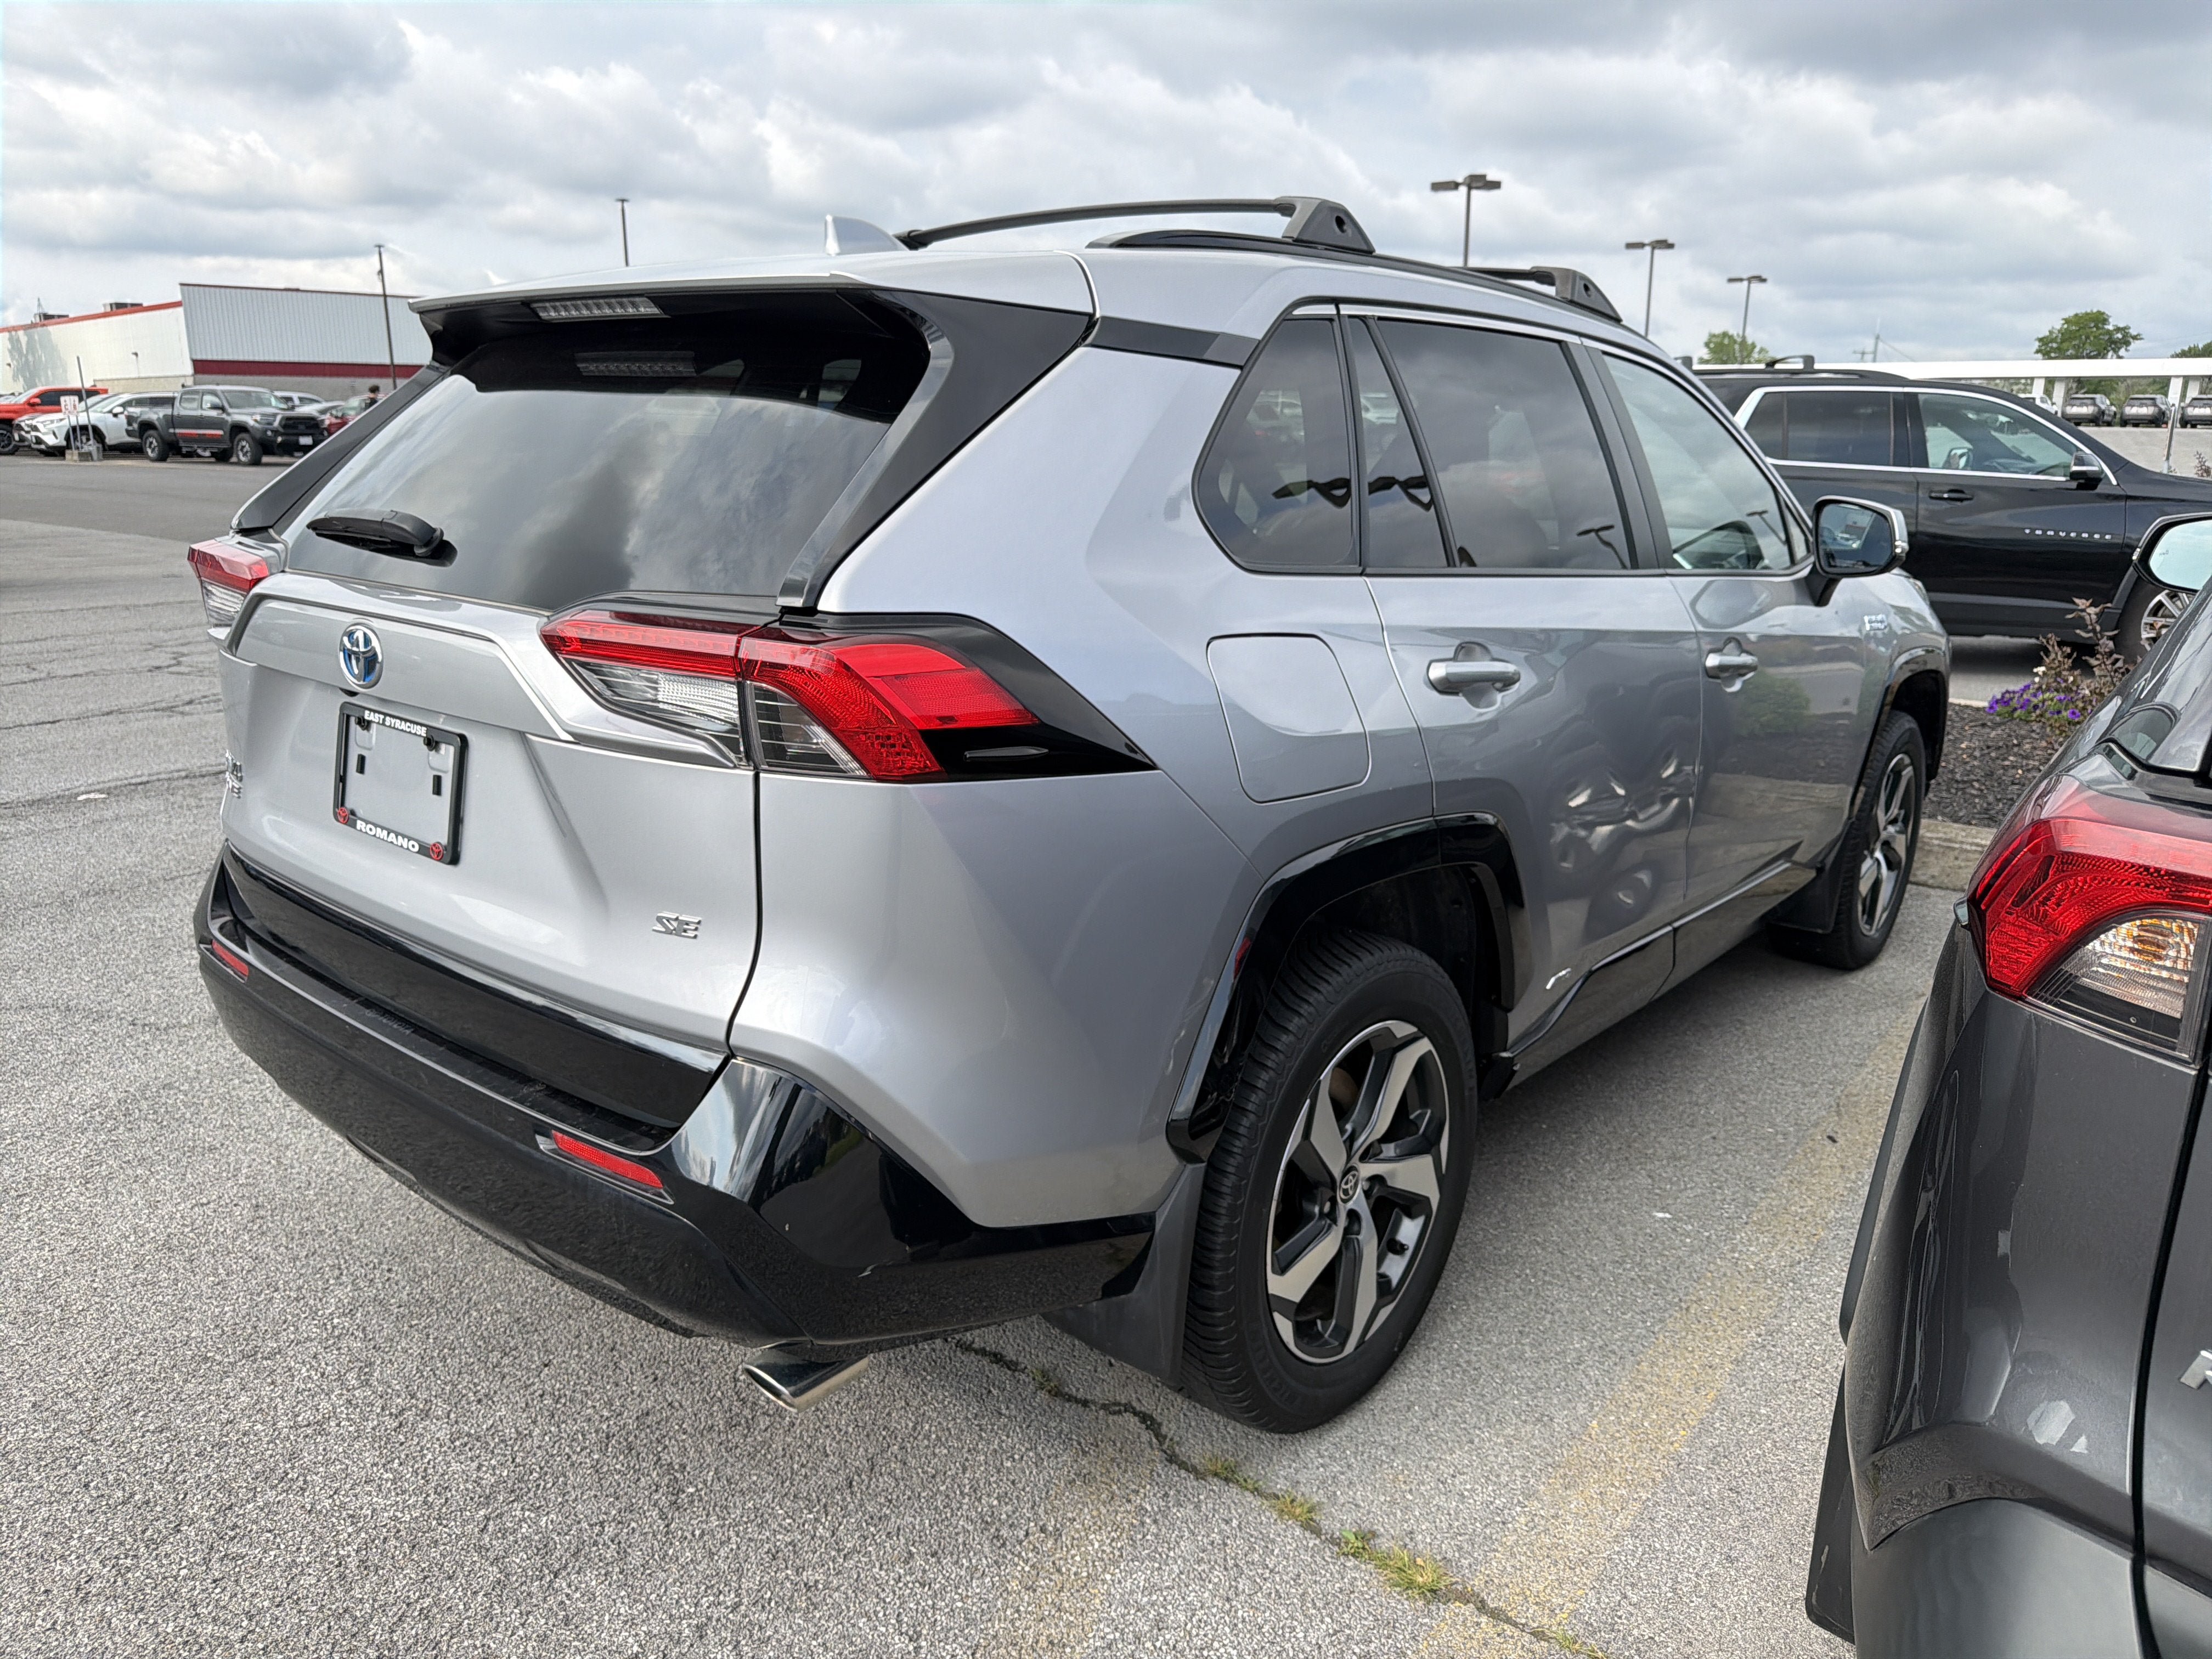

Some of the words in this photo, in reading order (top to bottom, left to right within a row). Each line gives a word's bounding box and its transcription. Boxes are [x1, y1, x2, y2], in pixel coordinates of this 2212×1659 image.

[364, 710, 384, 724] EAST
[385, 716, 427, 737] SYRACUSE
[357, 820, 419, 852] ROMANO
[652, 911, 702, 939] SE
